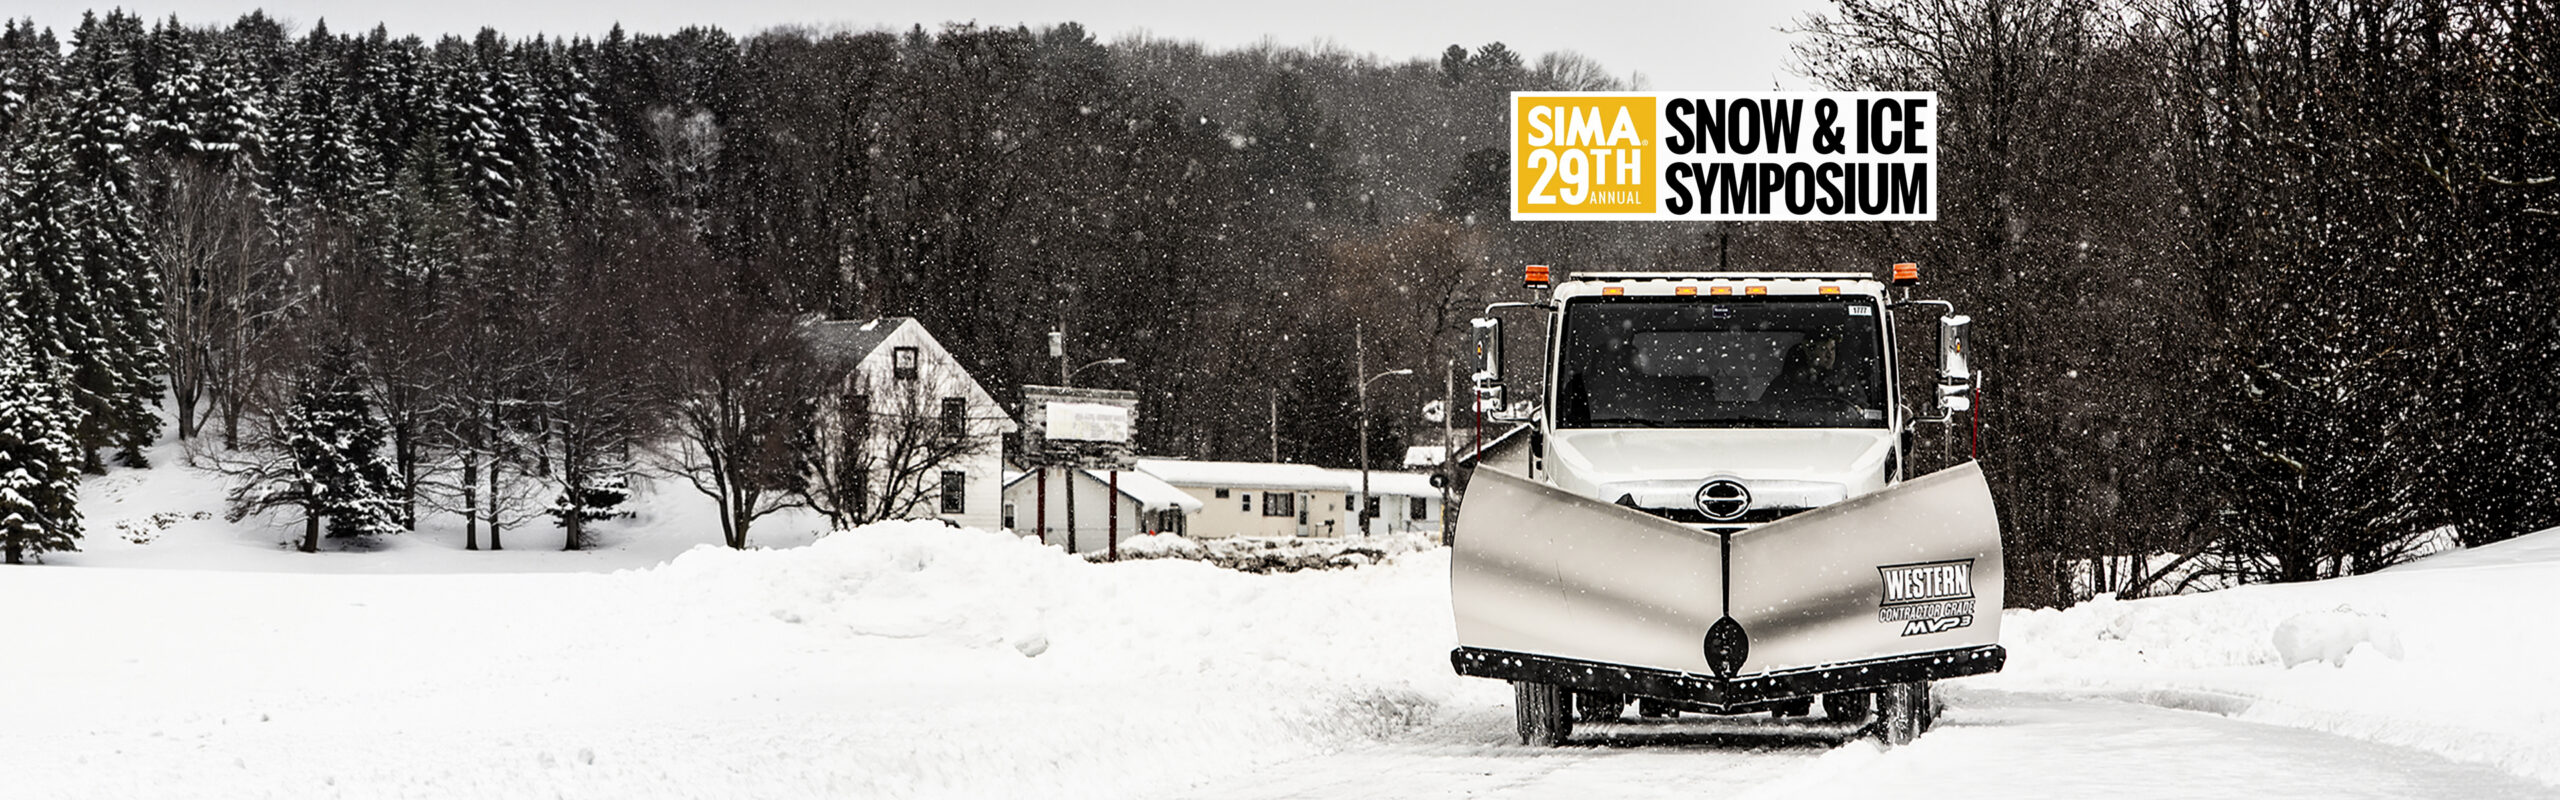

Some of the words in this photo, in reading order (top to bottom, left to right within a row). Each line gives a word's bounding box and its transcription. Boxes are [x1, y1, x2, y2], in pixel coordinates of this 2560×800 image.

[1885, 564, 1969, 601] WESTERN
[1879, 603, 1941, 622] CONTRACTOR
[1943, 600, 1975, 617] GRADE
